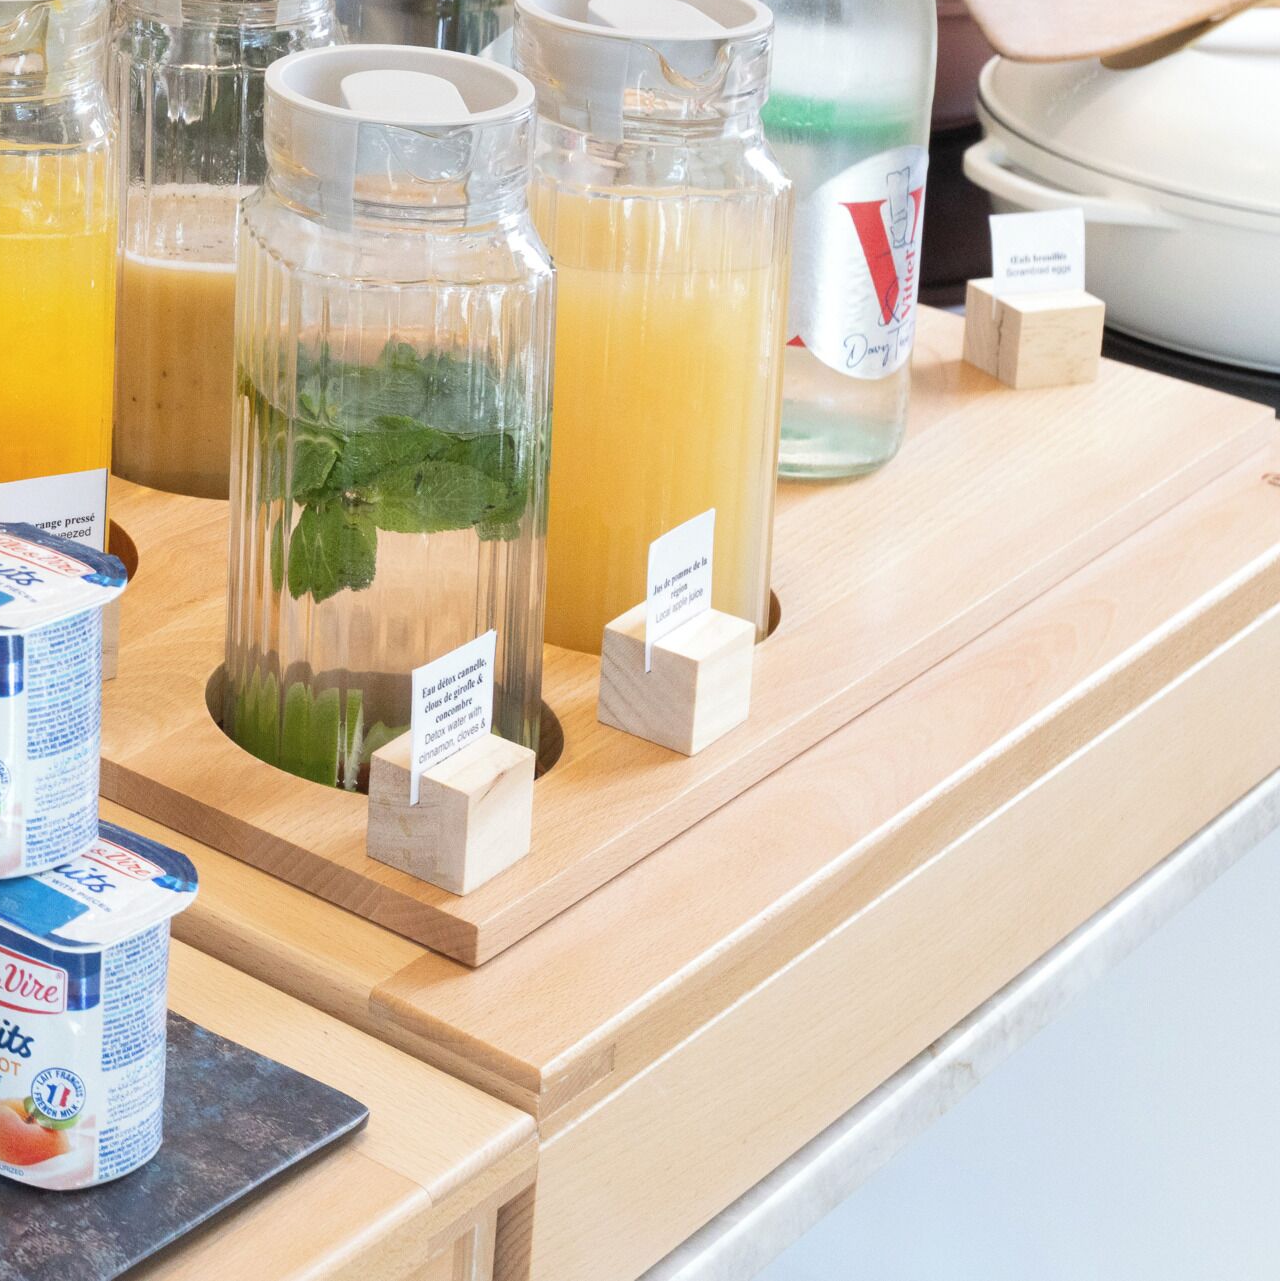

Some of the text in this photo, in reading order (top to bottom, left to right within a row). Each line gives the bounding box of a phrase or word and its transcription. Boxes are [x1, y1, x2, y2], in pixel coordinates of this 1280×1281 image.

[64, 512, 96, 528] pressé
[422, 686, 436, 699] Eau
[437, 673, 457, 692] détox
[424, 673, 484, 714] clous de girofle &
[435, 696, 473, 724] concombre
[424, 705, 483, 745] Detox water with
[456, 722, 480, 743] cloves
[3, 962, 60, 1004] Vire
